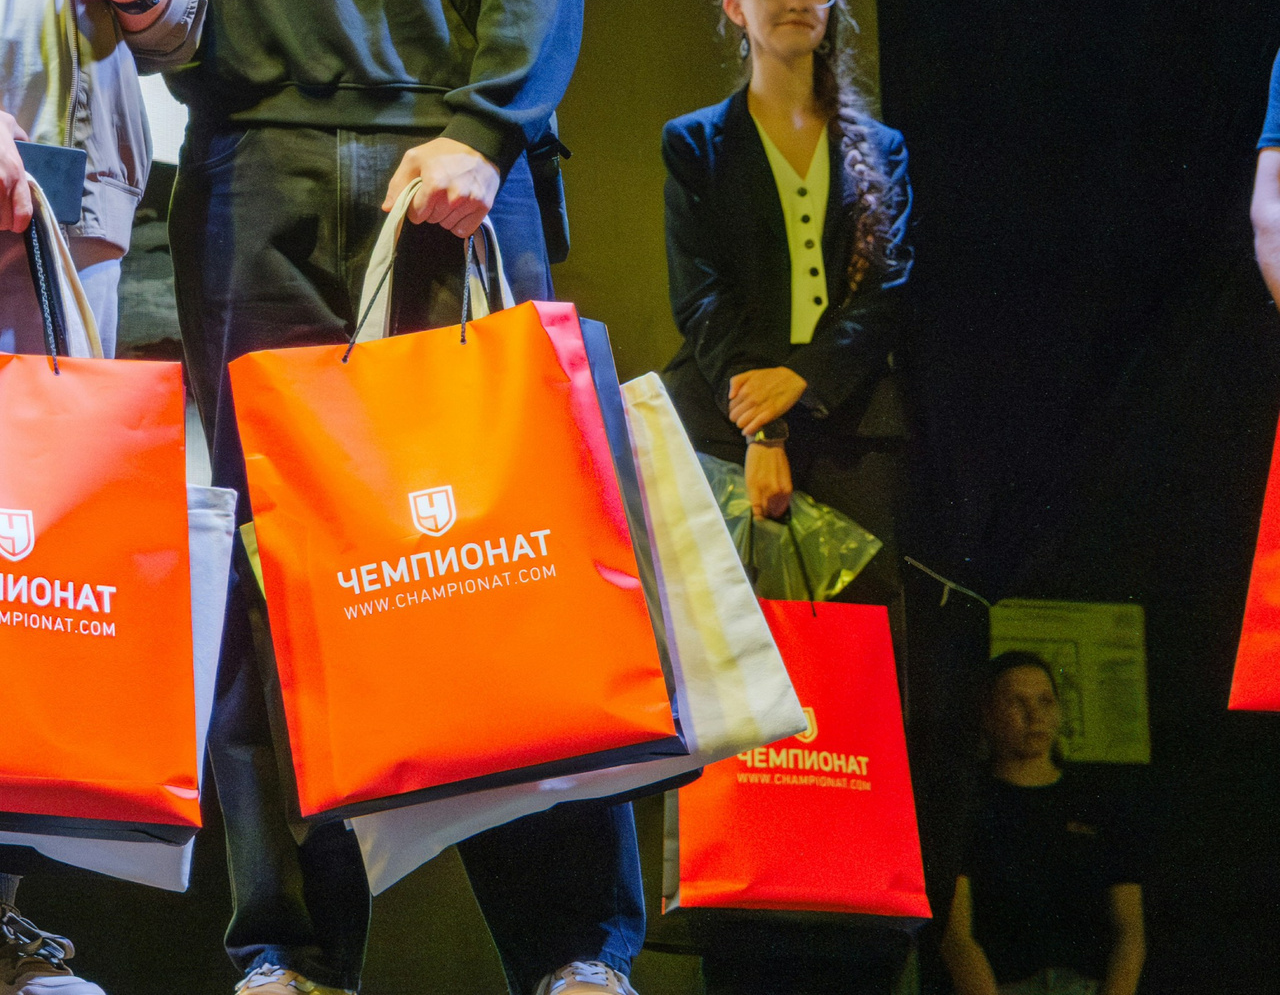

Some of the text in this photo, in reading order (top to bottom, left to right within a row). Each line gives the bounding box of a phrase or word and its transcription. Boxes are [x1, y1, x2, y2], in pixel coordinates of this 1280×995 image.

[337, 529, 552, 595] ЧЕМПИОНАТ
[344, 564, 557, 620] WWW.CHAMPIONAT.COM
[736, 772, 871, 791] WWW.CHAMPIONAT.COM
[737, 747, 869, 775] ЧЕМПИОНАТ
